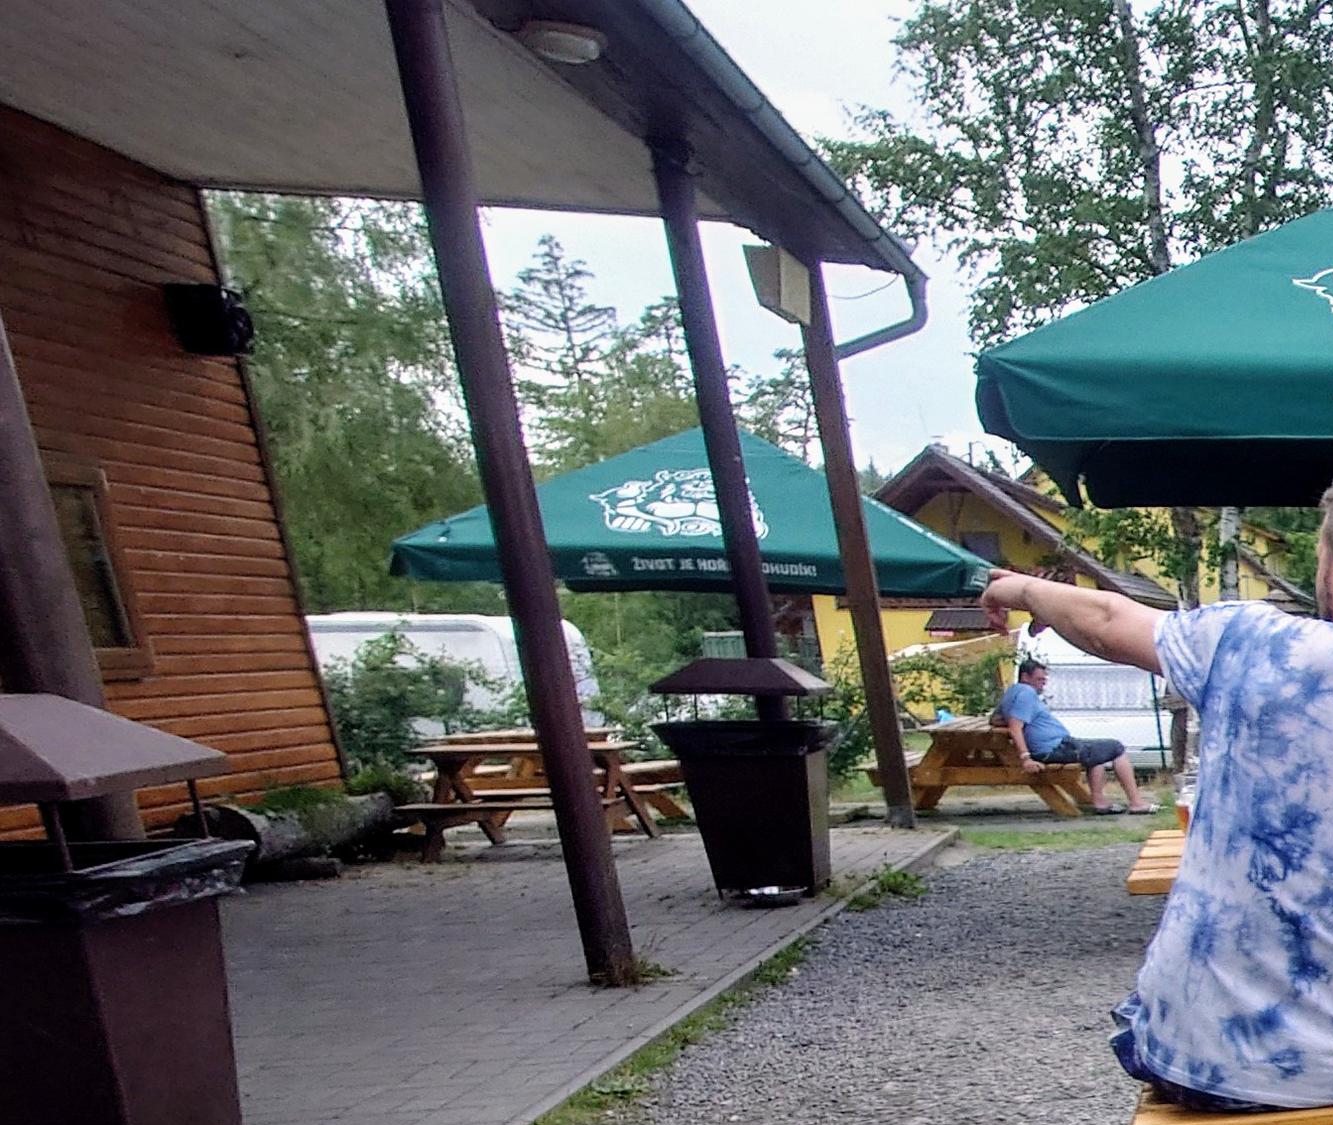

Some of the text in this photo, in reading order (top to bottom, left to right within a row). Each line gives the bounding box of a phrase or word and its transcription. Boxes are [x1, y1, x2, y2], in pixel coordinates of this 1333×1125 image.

[631, 556, 817, 577] ŽIVOT JE HOŘ OHUDÍK!
